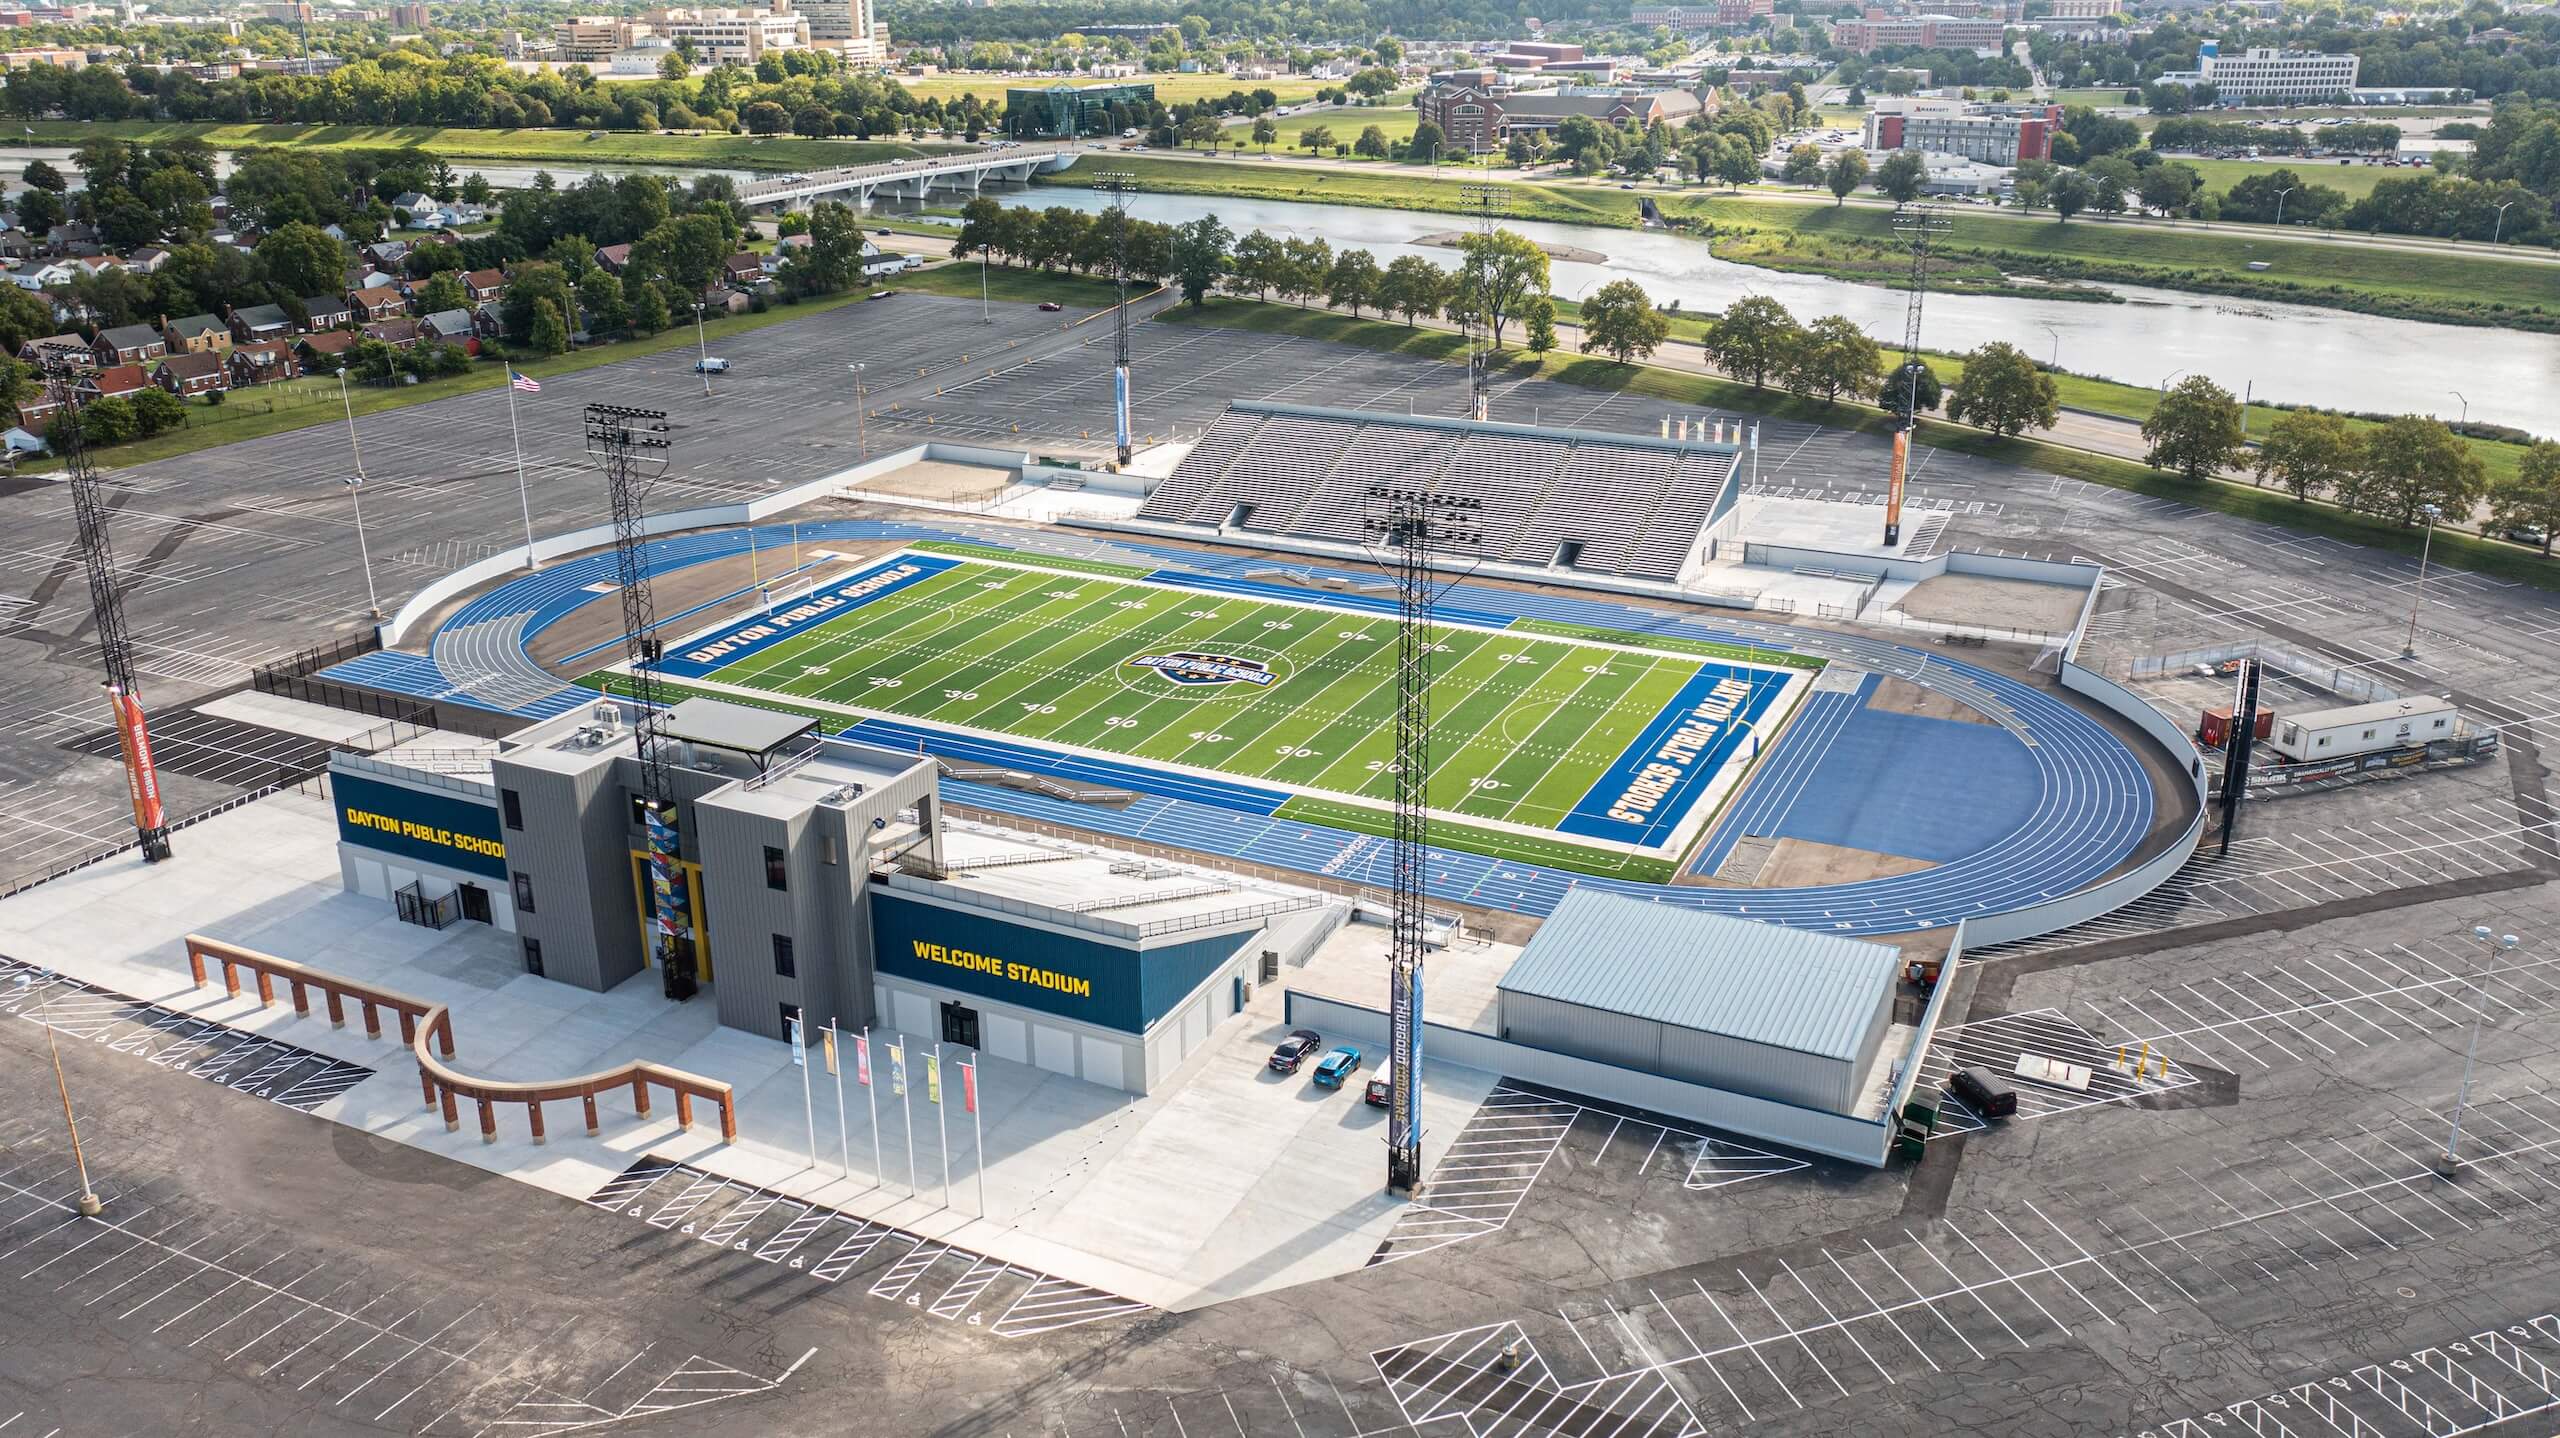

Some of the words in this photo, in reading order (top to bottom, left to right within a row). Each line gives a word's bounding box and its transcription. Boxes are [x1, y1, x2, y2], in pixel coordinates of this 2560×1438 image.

[687, 626, 778, 663] DAYTON
[770, 596, 846, 628] PUBLIC
[839, 564, 922, 598] SCHOOLS
[1263, 620, 1293, 630] 50
[1338, 631, 1368, 641] 40
[1498, 653, 1530, 664] 20
[805, 666, 831, 676] 10
[1134, 656, 1185, 668] DAYTON
[1185, 661, 1224, 674] PUBLIC
[1223, 669, 1273, 684] SCHOOLS
[1582, 665, 1608, 675] 10
[870, 678, 903, 688] 20
[946, 690, 979, 701] 30
[1691, 678, 1753, 722] DAYTON
[1023, 703, 1057, 714] 40
[1104, 716, 1138, 728] 50
[1188, 731, 1223, 743] 40
[1656, 719, 1719, 765] PUBLIC
[1275, 745, 1312, 757] 30
[133, 723, 150, 769] BELMONT
[143, 770, 156, 799] BISON
[1364, 760, 1405, 773] 20
[1469, 777, 1499, 790] 10
[1607, 762, 1682, 823] SCHOOLS
[347, 808, 400, 834] DAYTON
[402, 821, 452, 846] PUBLIC
[913, 940, 1003, 977] WELCOME
[1007, 962, 1090, 997] STADIUM
[1395, 999, 1407, 1064] THURGOOD
[1395, 1065, 1407, 1123] COUGARS
